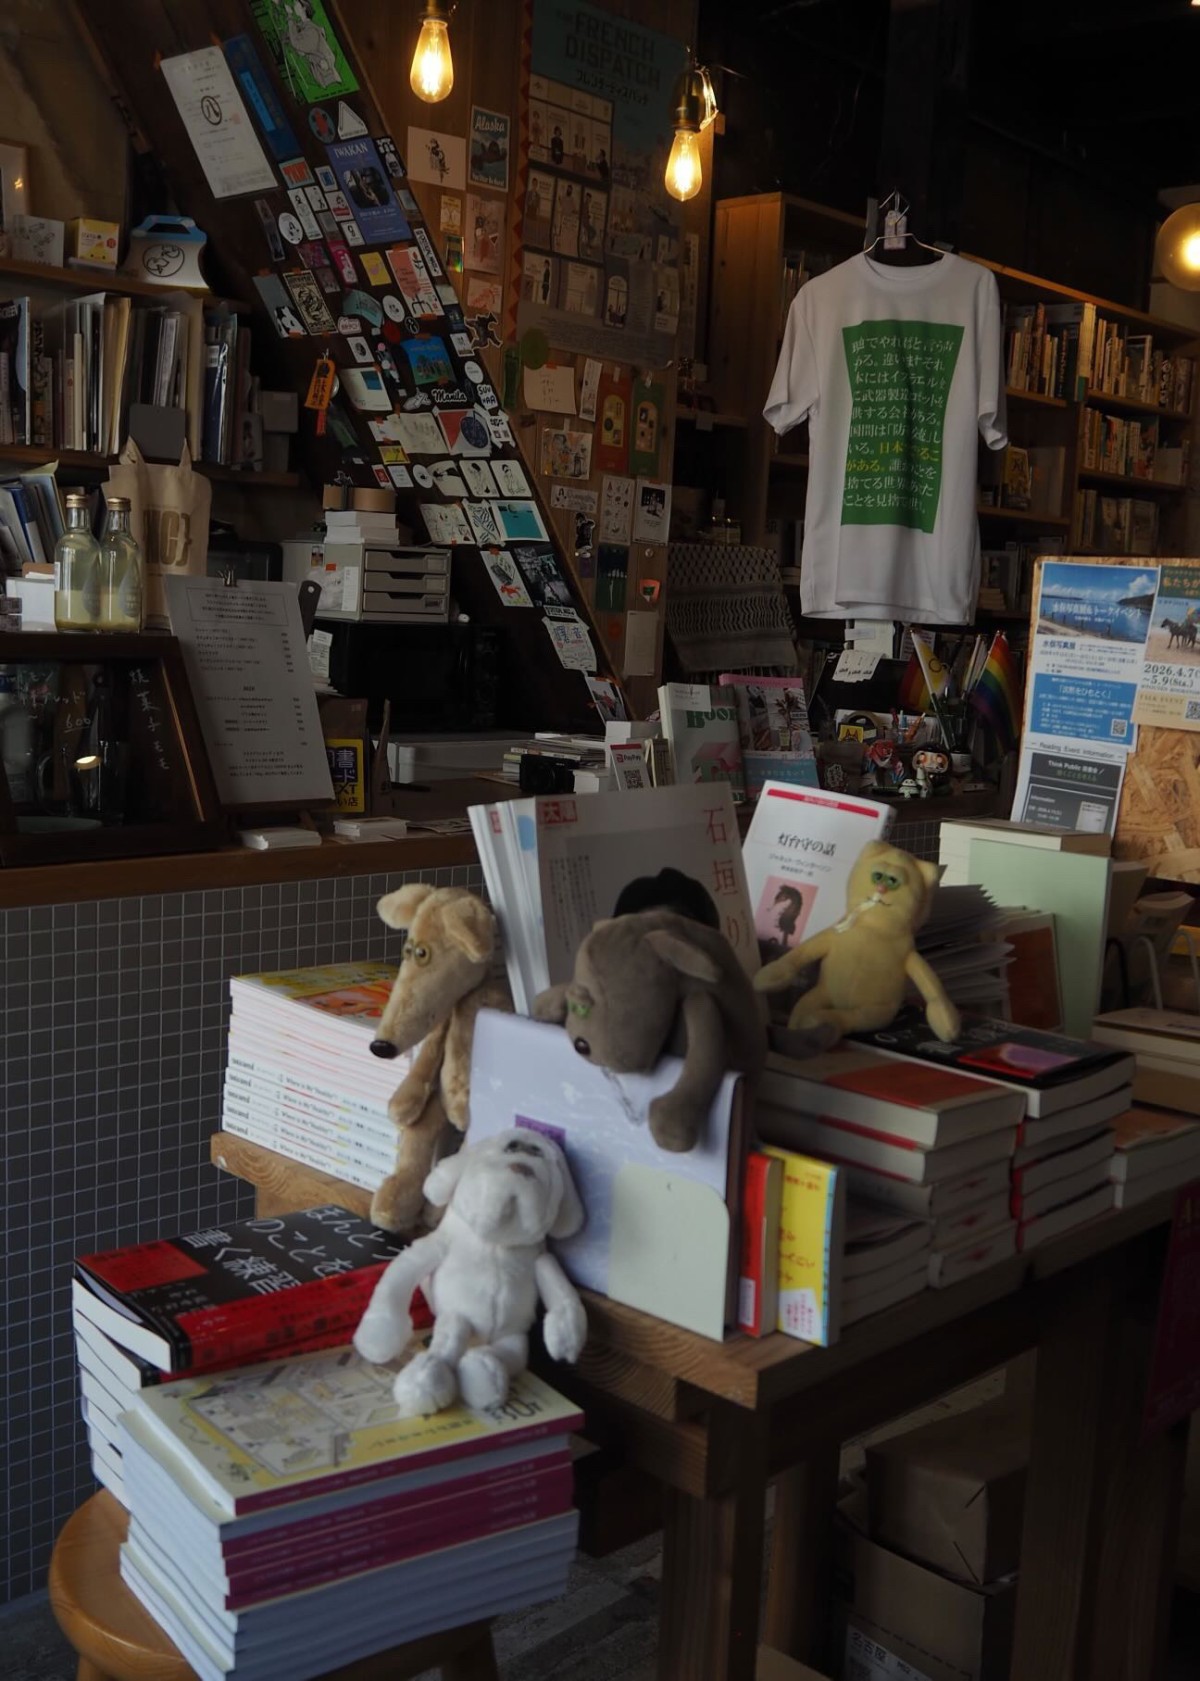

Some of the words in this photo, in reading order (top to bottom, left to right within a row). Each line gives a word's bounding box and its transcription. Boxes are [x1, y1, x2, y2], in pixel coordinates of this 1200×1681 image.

[565, 35, 661, 91] DISPATCH
[575, 11, 656, 63] FRENCH
[474, 115, 505, 133] Alaska
[333, 143, 369, 159] IWAKAN
[623, 753, 642, 761] PayPay
[182, 1228, 303, 1295] 書く練習
[246, 1218, 355, 1279] のことを
